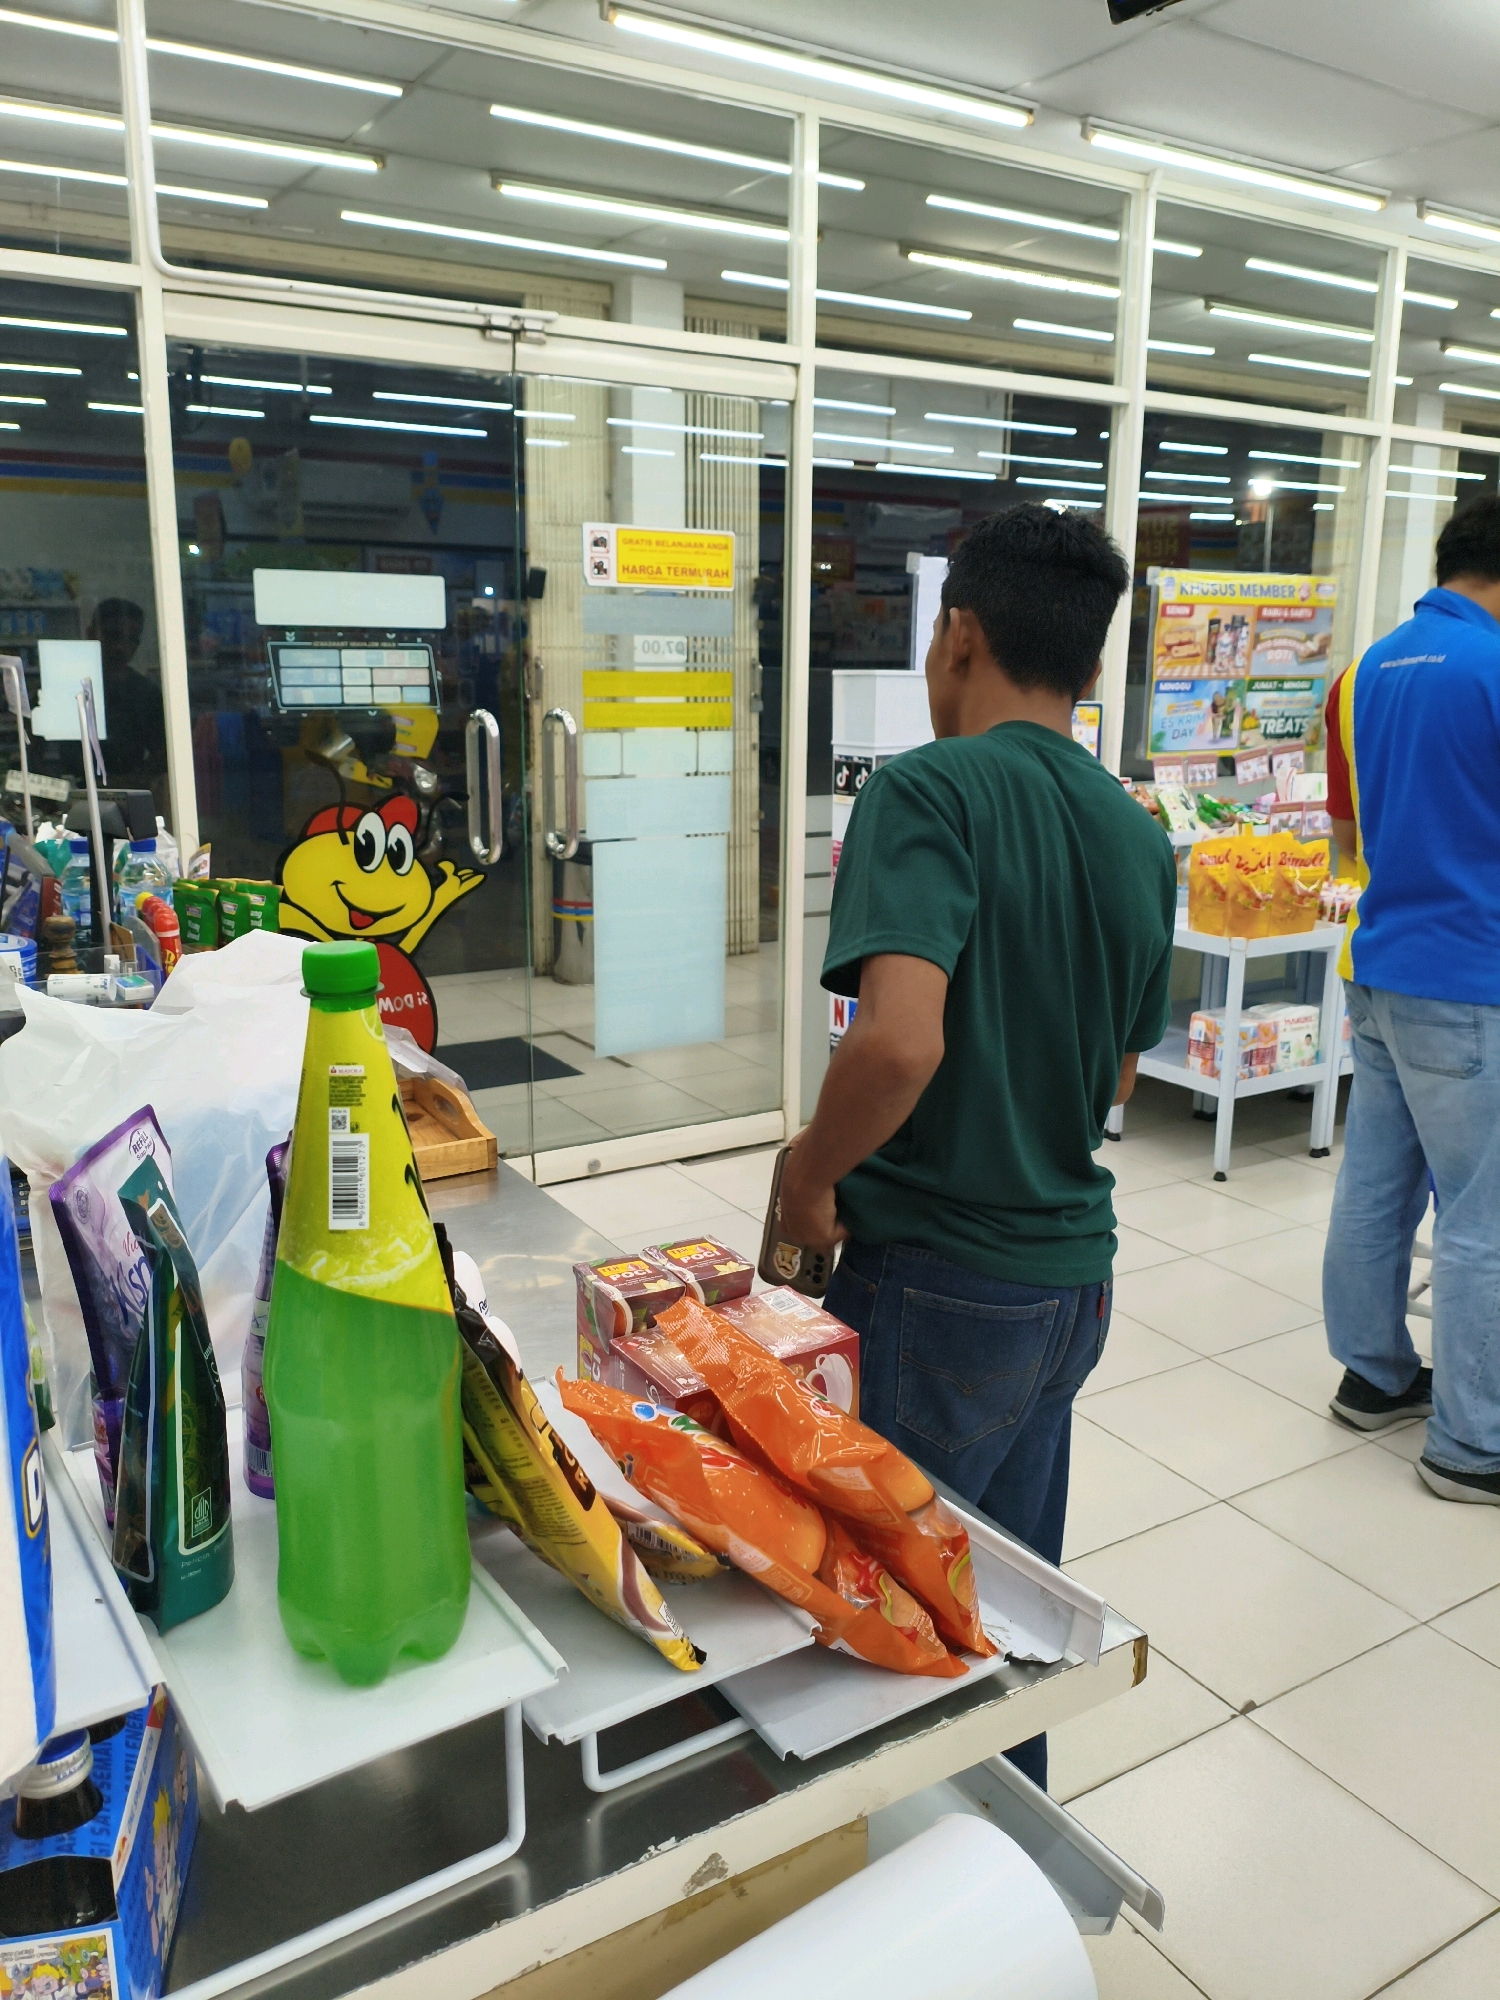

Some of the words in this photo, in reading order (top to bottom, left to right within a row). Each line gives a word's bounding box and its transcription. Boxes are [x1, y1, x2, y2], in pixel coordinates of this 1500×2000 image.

[622, 537, 652, 547] GRATIS
[655, 539, 704, 549] BELANJAAN
[707, 542, 729, 551] ANDA
[622, 564, 663, 575] HARGA
[666, 566, 729, 579] TERMURAH
[1179, 582, 1236, 597] KHUSUS
[1239, 583, 1296, 598] MEMBER
[1158, 681, 1192, 691] MINGGU
[1252, 681, 1277, 690] JUMAT
[1283, 681, 1311, 690] MINGGU
[1160, 716, 1175, 728] ES
[1178, 713, 1205, 728] KRIM
[1259, 717, 1310, 735] TREATS
[1171, 729, 1196, 740] DAY
[834, 997, 845, 1029] N
[671, 1247, 689, 1255] TEH
[680, 1249, 722, 1264] POCI
[601, 1265, 619, 1273] TEH
[609, 1268, 653, 1282] POCI
